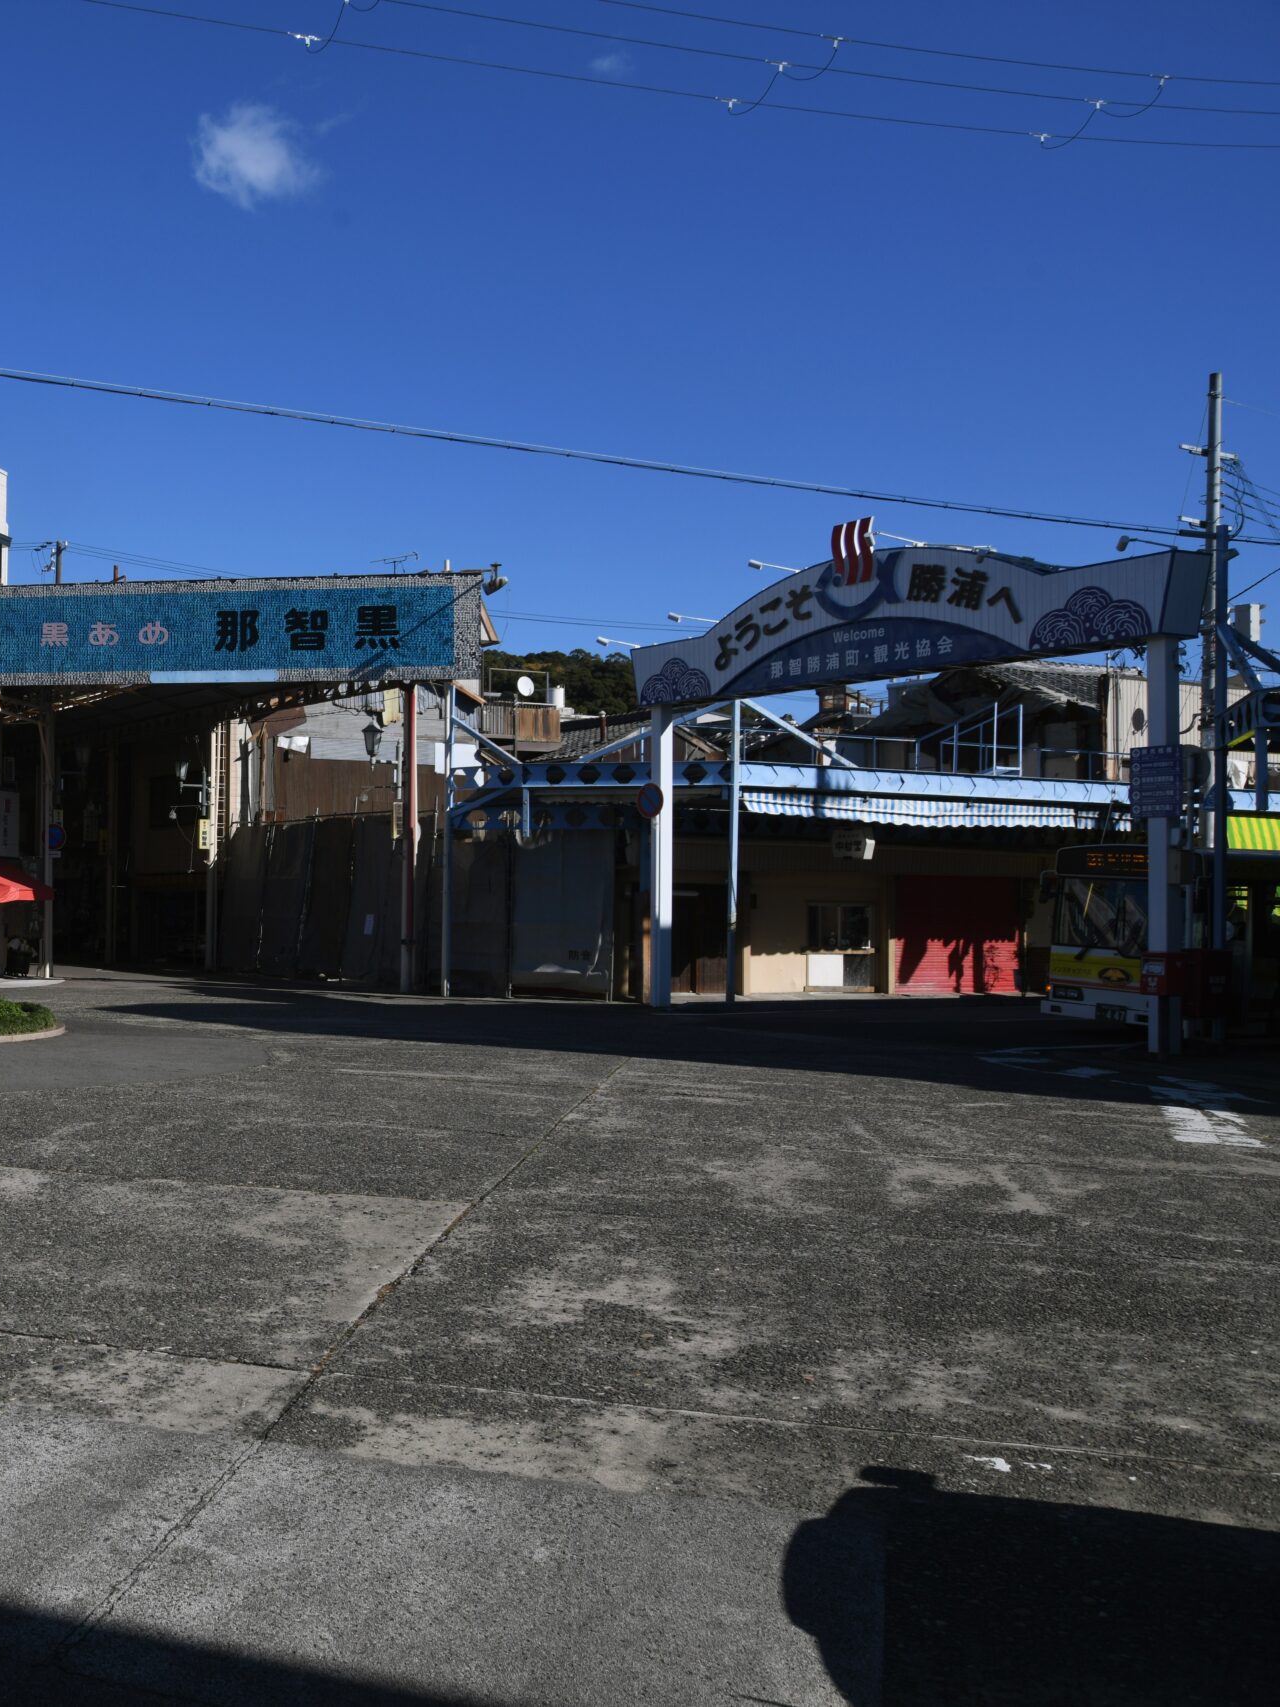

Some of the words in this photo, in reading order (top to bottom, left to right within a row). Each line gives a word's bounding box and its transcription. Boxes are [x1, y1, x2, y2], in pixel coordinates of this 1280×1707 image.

[39, 621, 170, 648] 黒あめ
[214, 605, 401, 653] 那智黒
[714, 584, 814, 671] ようこそ
[906, 563, 1023, 625] 勝浦へ
[833, 627, 886, 643] Welcome
[769, 635, 954, 679] 那智勝浦町・観光協会
